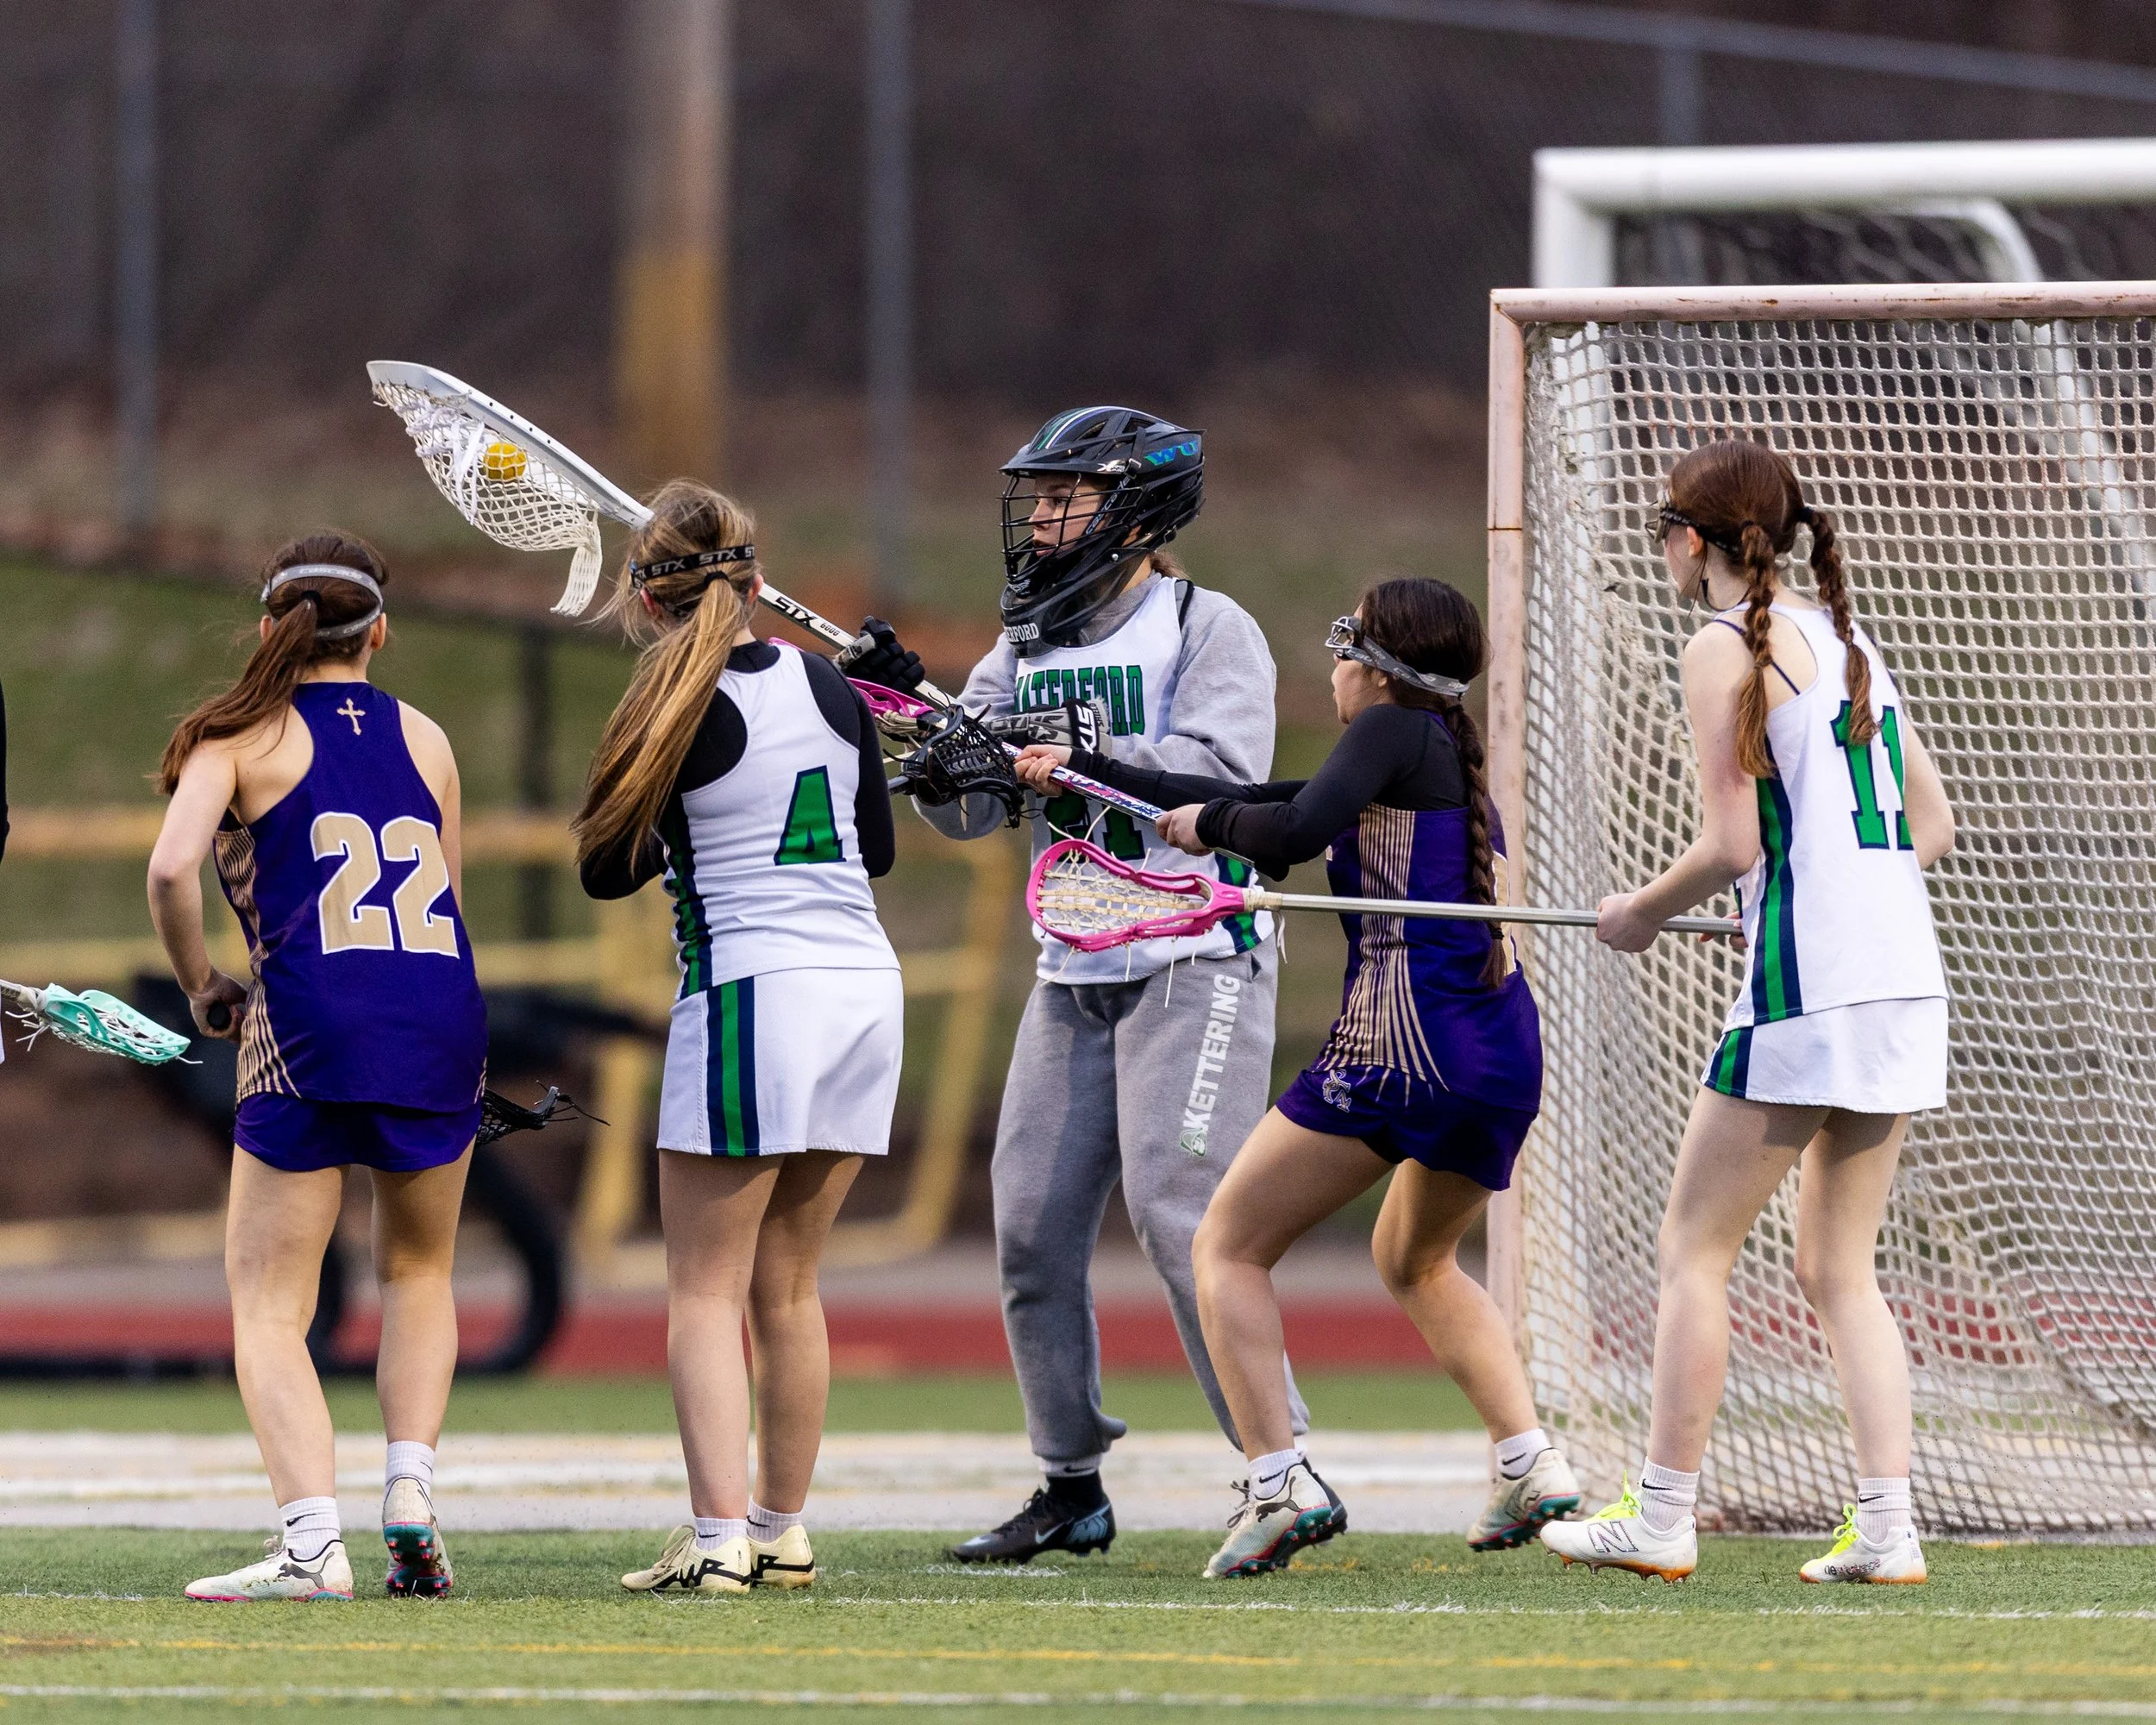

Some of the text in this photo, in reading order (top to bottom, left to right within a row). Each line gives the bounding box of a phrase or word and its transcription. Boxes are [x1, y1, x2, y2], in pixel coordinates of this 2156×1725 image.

[1144, 440, 1199, 466] WU
[651, 559, 686, 576] STX
[699, 548, 737, 565] STX
[773, 596, 817, 628] STX
[1829, 699, 1915, 850] 11
[774, 764, 847, 866] 4
[310, 812, 460, 959] 22
[1182, 973, 1240, 1132] KETTERING
